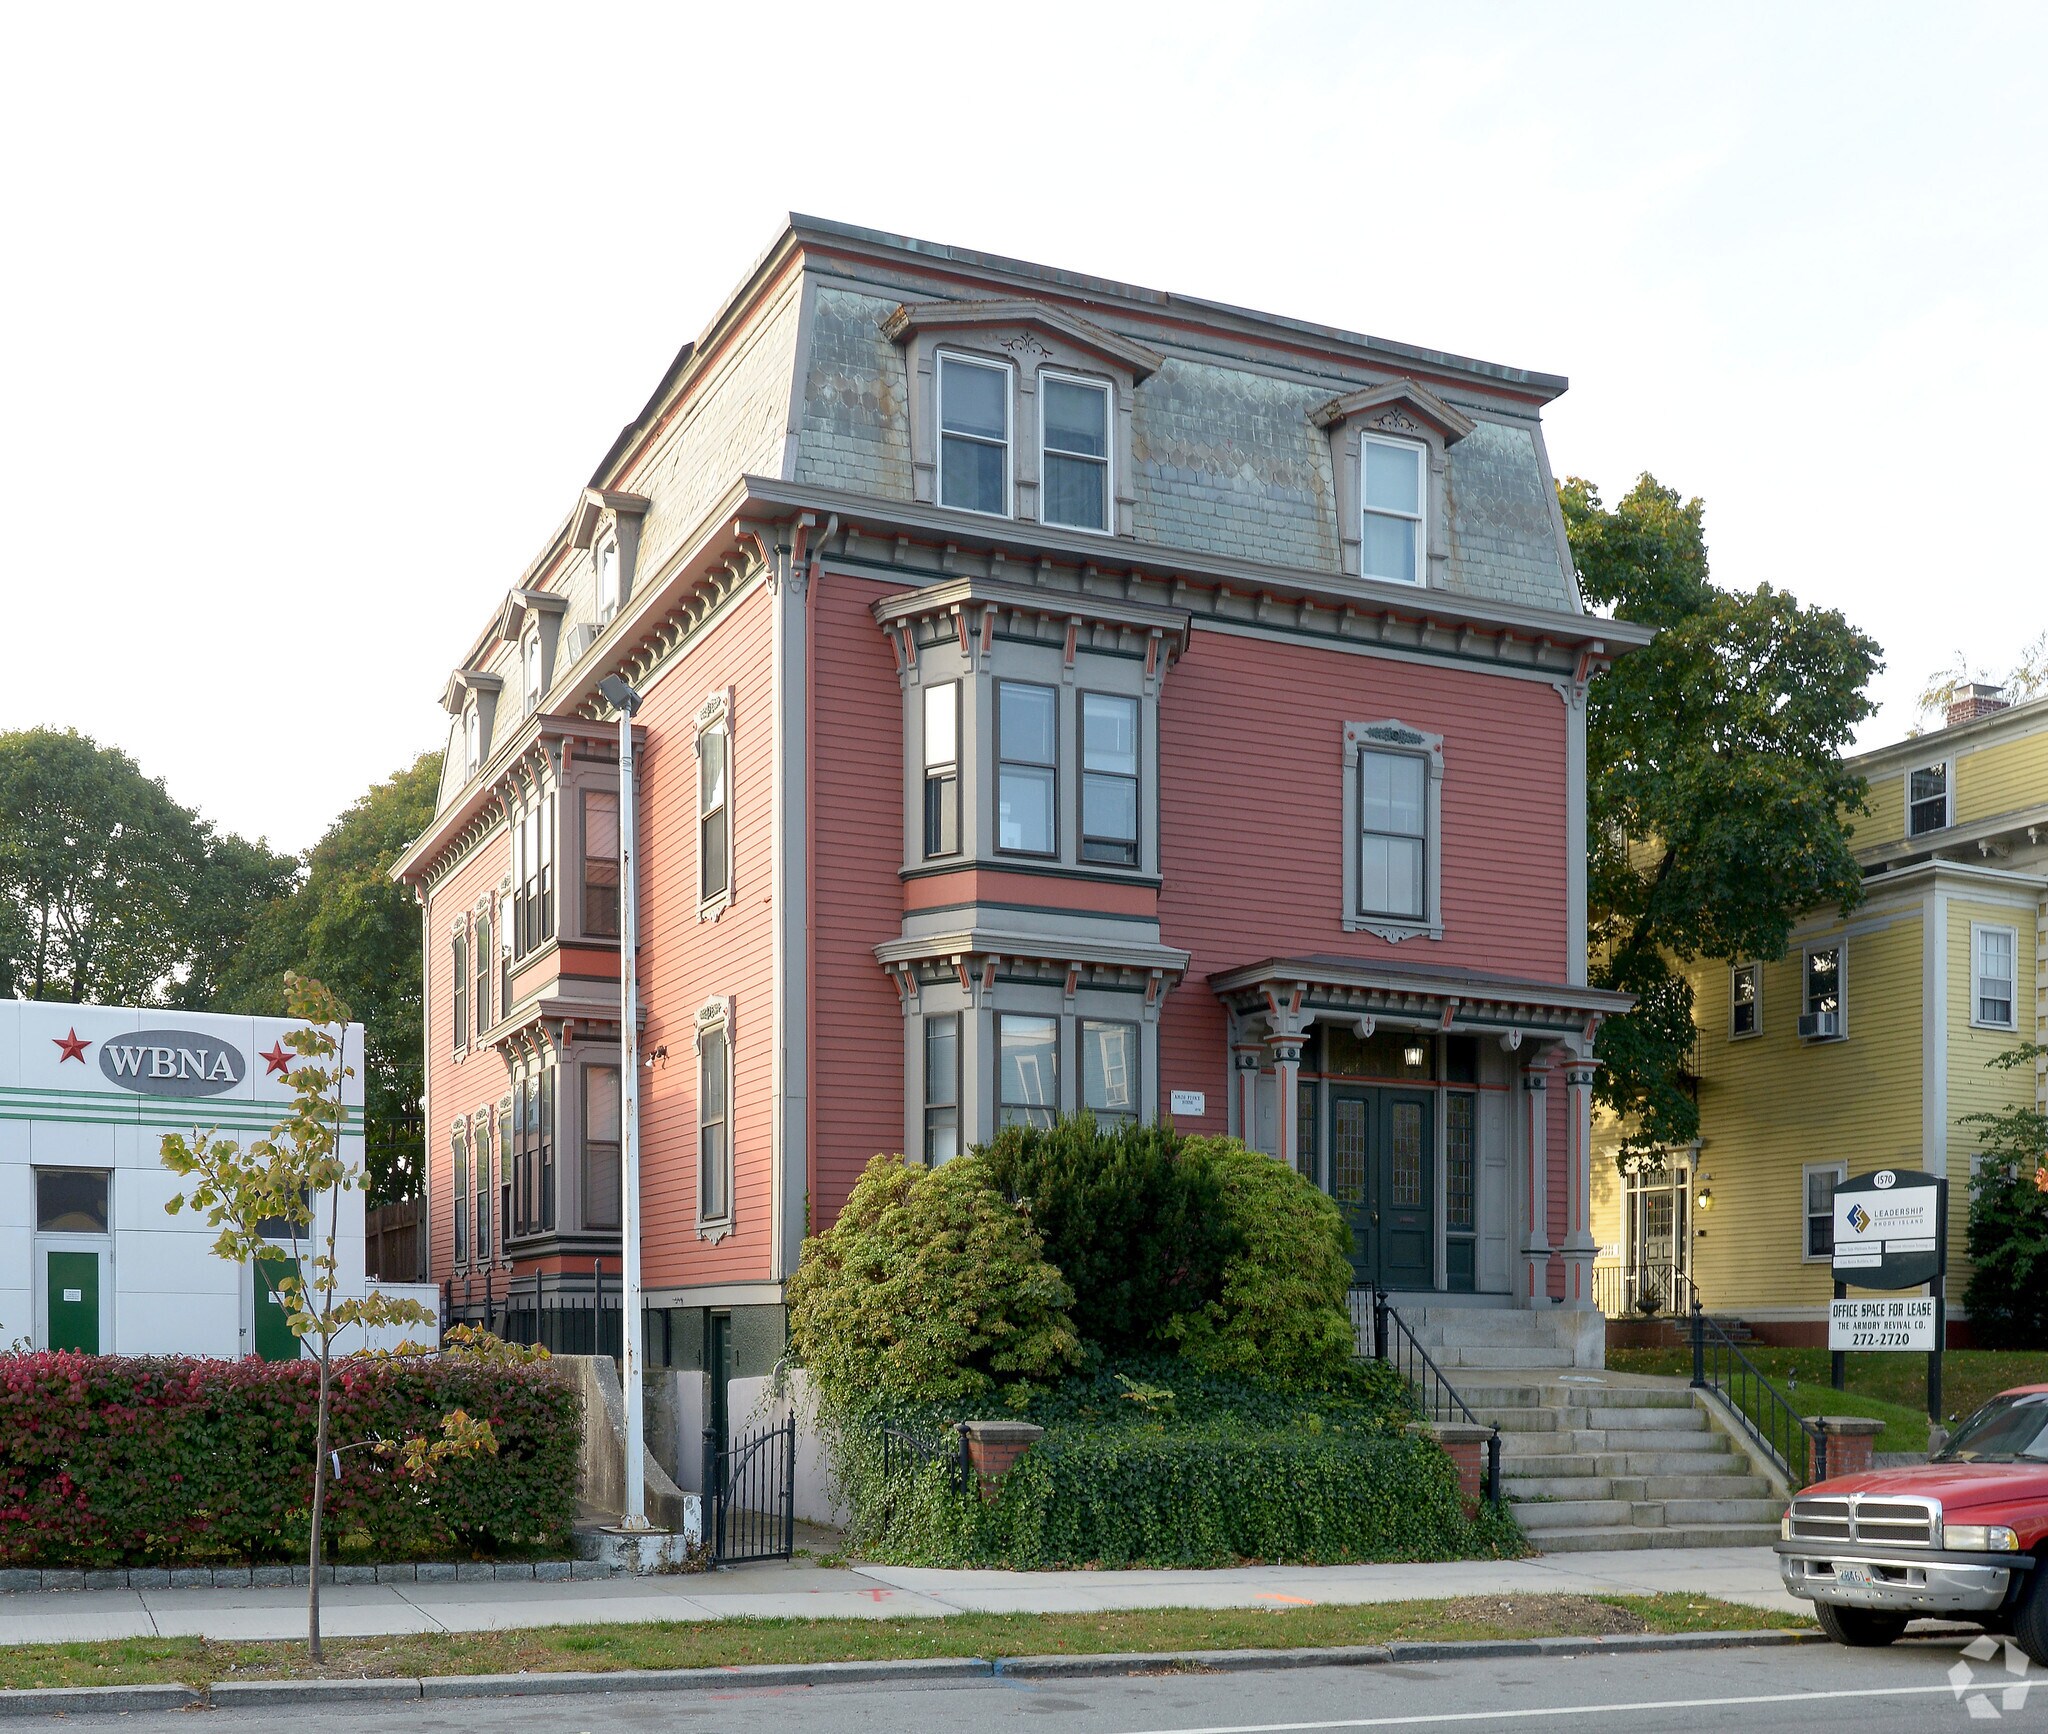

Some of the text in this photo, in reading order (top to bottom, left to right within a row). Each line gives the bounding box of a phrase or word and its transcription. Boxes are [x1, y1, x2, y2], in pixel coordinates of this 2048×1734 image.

[105, 1045, 238, 1082] WBNA
[1877, 1175, 1893, 1185] 1570
[1874, 1207, 1924, 1218] LEADERSHIP
[1833, 1302, 1932, 1318] OFFICE SPACE FOR LEASE
[1838, 1320, 1926, 1330] THE ARMORY REVIVAL CO.
[1852, 1333, 1910, 1346] 272-2720
